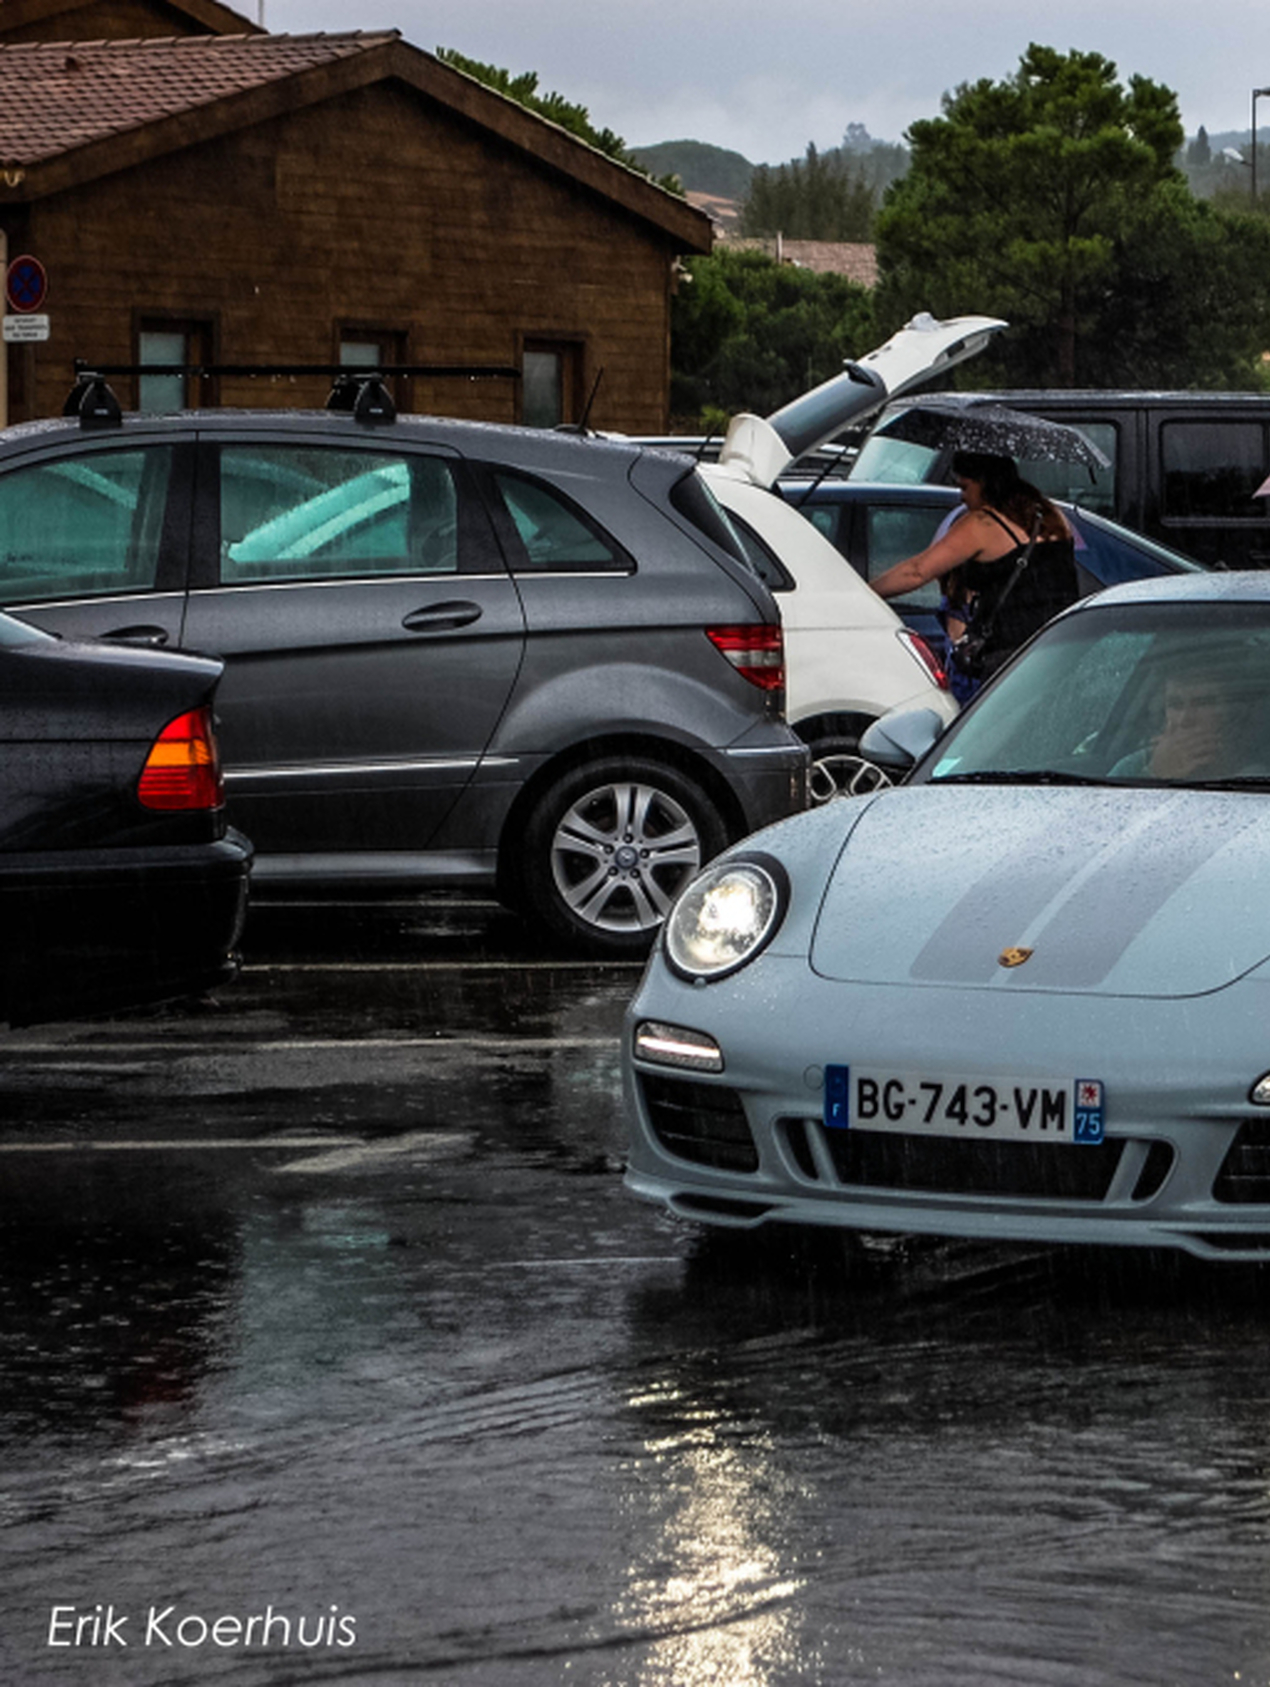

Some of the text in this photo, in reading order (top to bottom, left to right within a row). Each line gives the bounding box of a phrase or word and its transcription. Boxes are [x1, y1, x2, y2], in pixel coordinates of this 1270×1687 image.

[832, 1103, 840, 1118] F
[857, 1078, 1067, 1131] BG-743-VM
[1076, 1112, 1101, 1136] 75
